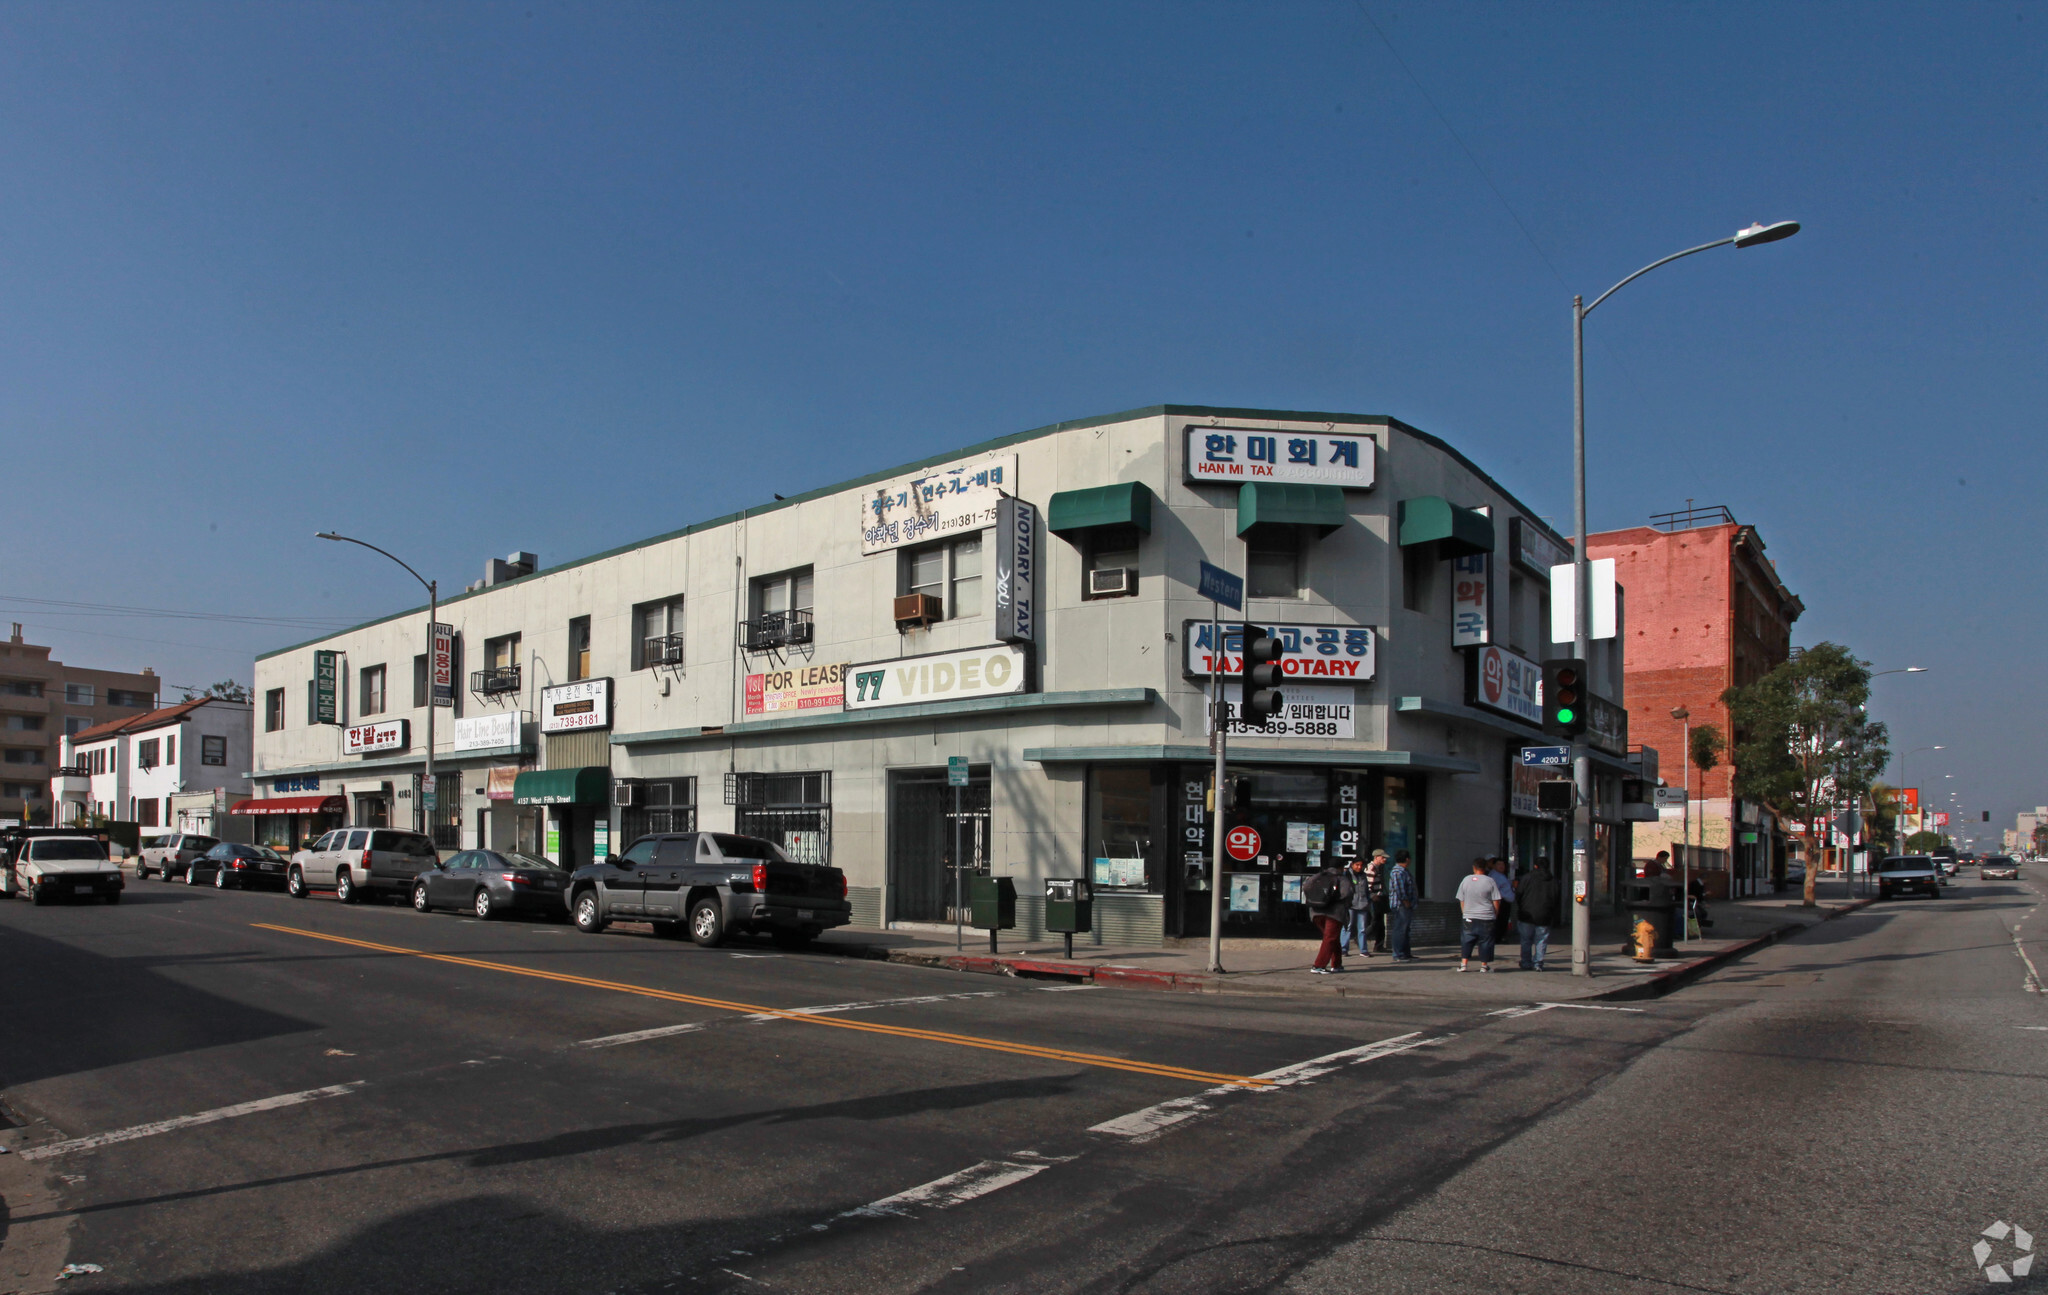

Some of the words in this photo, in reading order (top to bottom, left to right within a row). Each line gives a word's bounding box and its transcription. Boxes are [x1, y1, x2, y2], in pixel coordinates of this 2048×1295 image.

[1205, 434, 1359, 468] 한미회계
[1198, 463, 1225, 474] HAN
[1229, 464, 1244, 475] MI
[1251, 465, 1274, 476] TAX
[1287, 467, 1365, 481] ACCOUNTING
[871, 491, 908, 515] 정수기
[921, 477, 961, 503] 연수기
[902, 511, 940, 540] 정수기
[1017, 505, 1030, 583] NOTARY
[1202, 570, 1241, 600] Western
[1017, 599, 1029, 636] TAX
[435, 637, 450, 685] 미용실
[747, 675, 762, 693] 1st
[764, 670, 793, 692] FOR
[855, 670, 886, 702] 77
[896, 654, 1012, 697] VIDEO
[783, 690, 797, 699] OFFICE
[800, 687, 817, 697] Newly
[747, 706, 763, 714] Free
[457, 722, 472, 741] Hair
[474, 718, 489, 738] Line
[1541, 756, 1559, 764] 4200
[543, 795, 555, 803] Fifth
[556, 795, 571, 803] Street
[1229, 831, 1257, 855] 약
